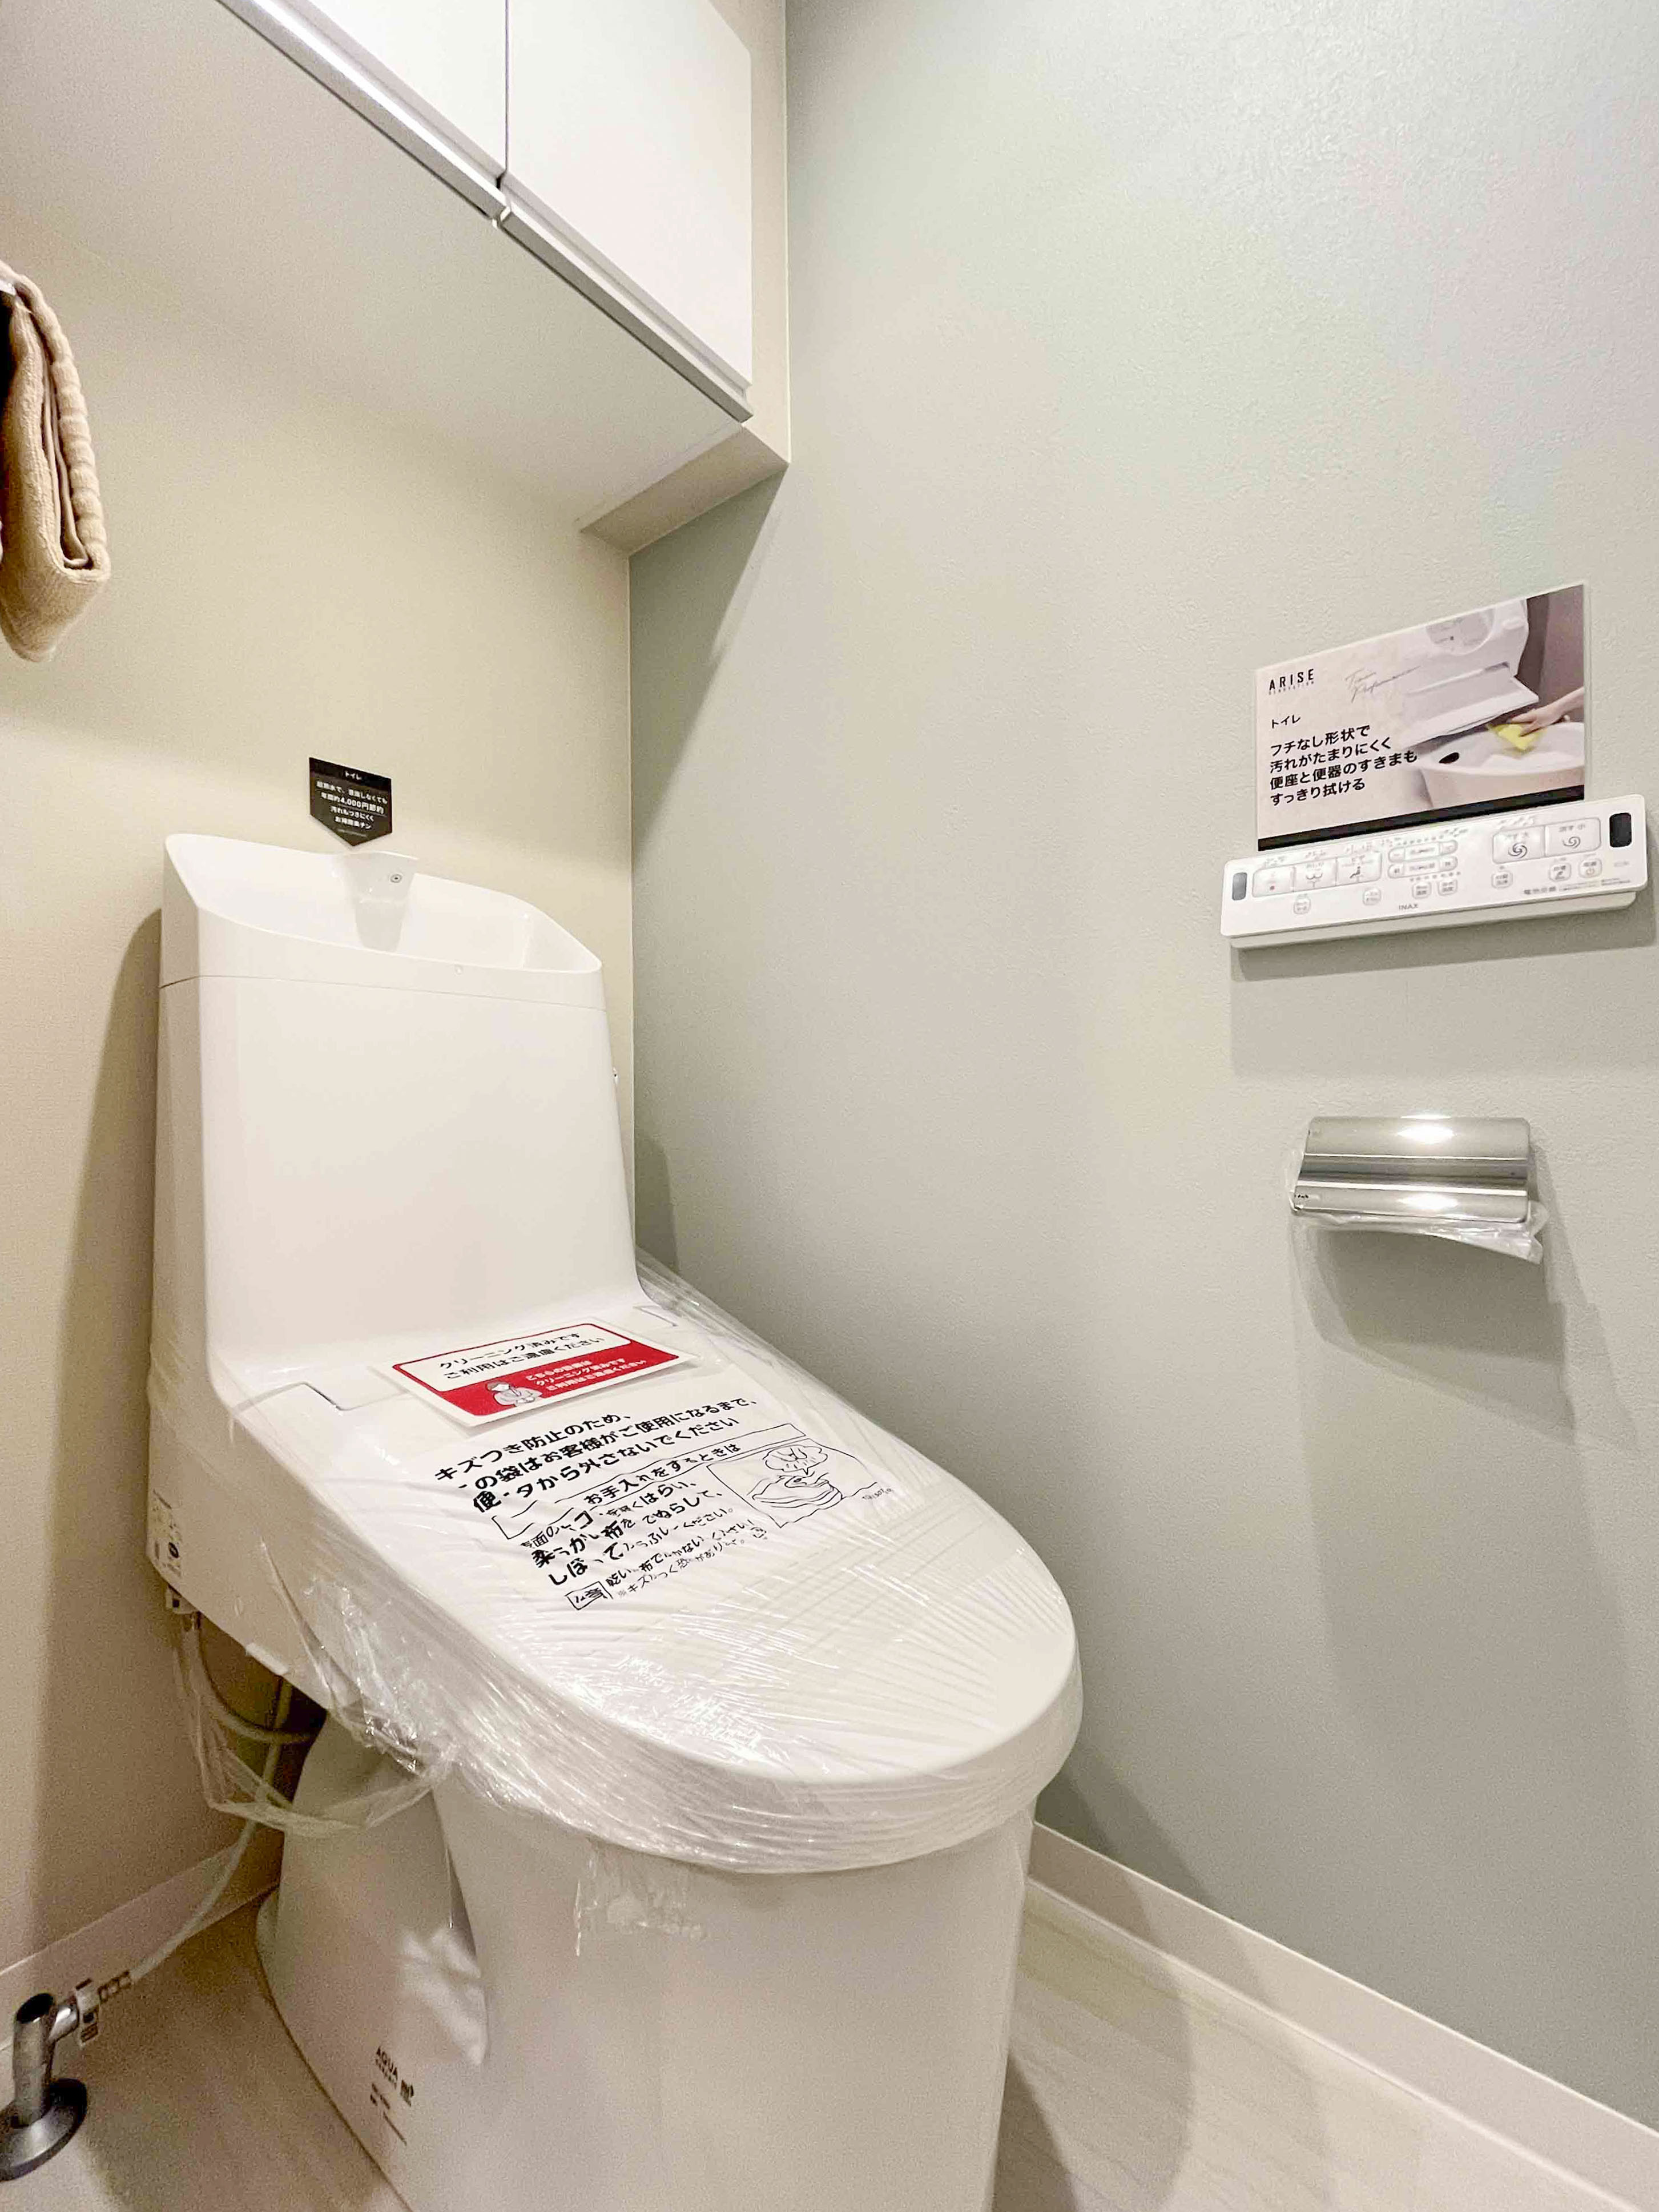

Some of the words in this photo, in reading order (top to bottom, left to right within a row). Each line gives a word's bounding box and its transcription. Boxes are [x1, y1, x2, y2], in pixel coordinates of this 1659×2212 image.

[1269, 669, 1314, 691] ARISE
[1271, 714, 1301, 729] トイレ
[1270, 725, 1370, 757] フチなし形状で
[1270, 737, 1391, 773] 汚れがたまりにくく
[345, 770, 363, 781] トイレ
[1270, 750, 1418, 790] 便座と便器のすきまも
[1270, 778, 1366, 806] すっきり拭ける
[440, 1333, 581, 1369] クリーニング済みです
[444, 1338, 605, 1379] ご利用はご遠慮ください
[435, 1414, 631, 1480] キズつき防止のため、
[458, 1398, 756, 1489] の袋はお客様がご使用になるまで、
[473, 1418, 740, 1513] 便タから外さないでください
